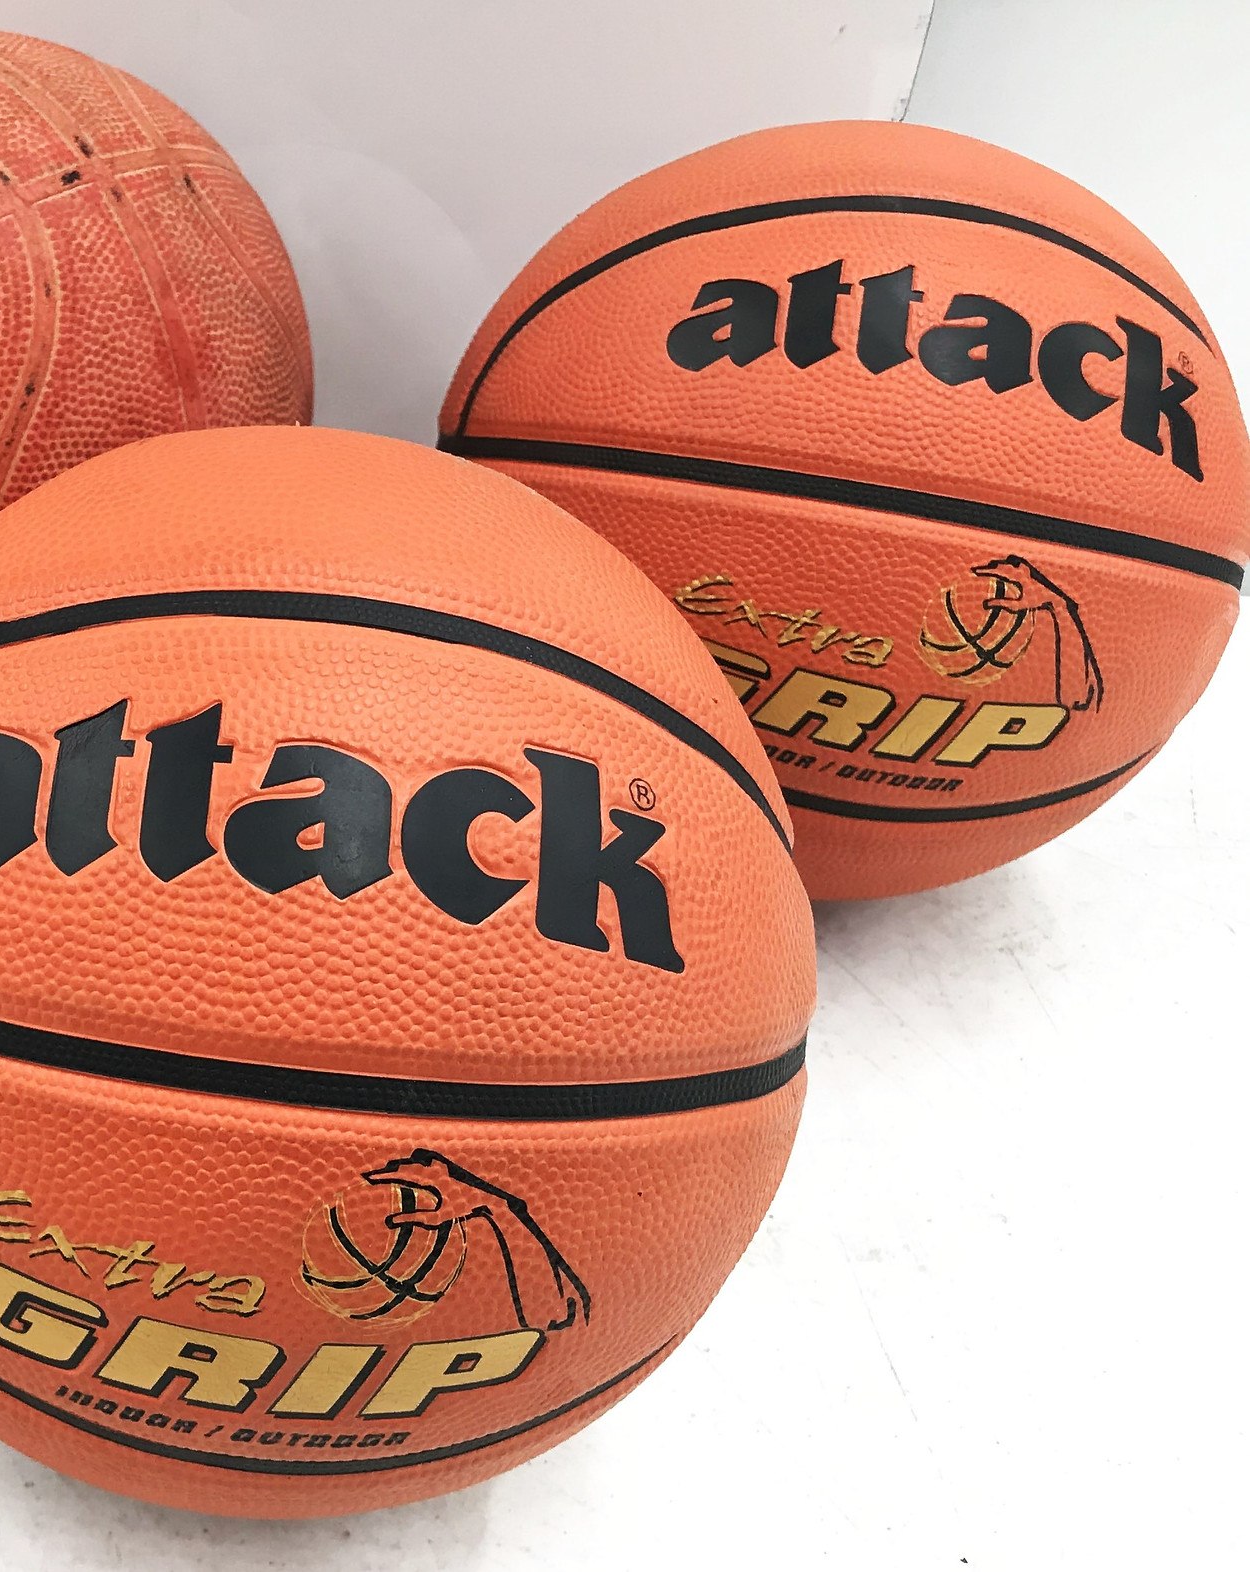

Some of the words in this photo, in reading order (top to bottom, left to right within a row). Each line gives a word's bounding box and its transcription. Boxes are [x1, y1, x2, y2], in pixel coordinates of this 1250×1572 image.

[665, 258, 1204, 483] attack
[674, 573, 894, 669] Extra
[835, 764, 964, 793] OUTDOOR
[230, 1428, 412, 1447] OUTDOOR
